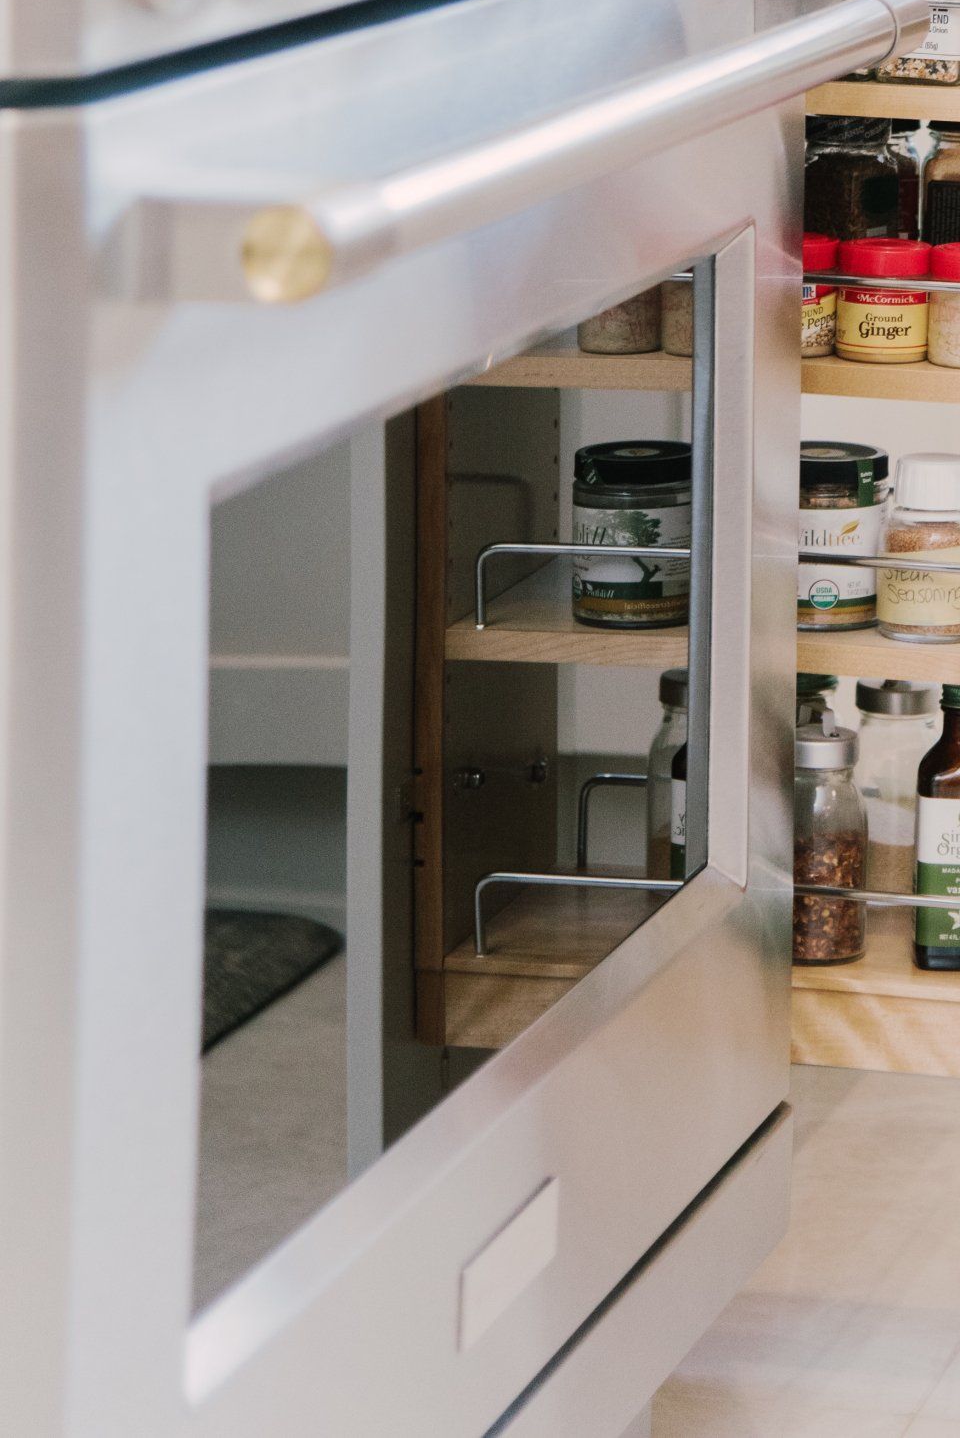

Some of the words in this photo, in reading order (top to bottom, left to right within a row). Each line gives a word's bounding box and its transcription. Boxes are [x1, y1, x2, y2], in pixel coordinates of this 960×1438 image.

[859, 293, 915, 303] McCormick
[865, 312, 903, 322] Ground
[858, 321, 912, 340] Ginger
[799, 527, 860, 547] ildtree
[815, 586, 833, 594] USDA
